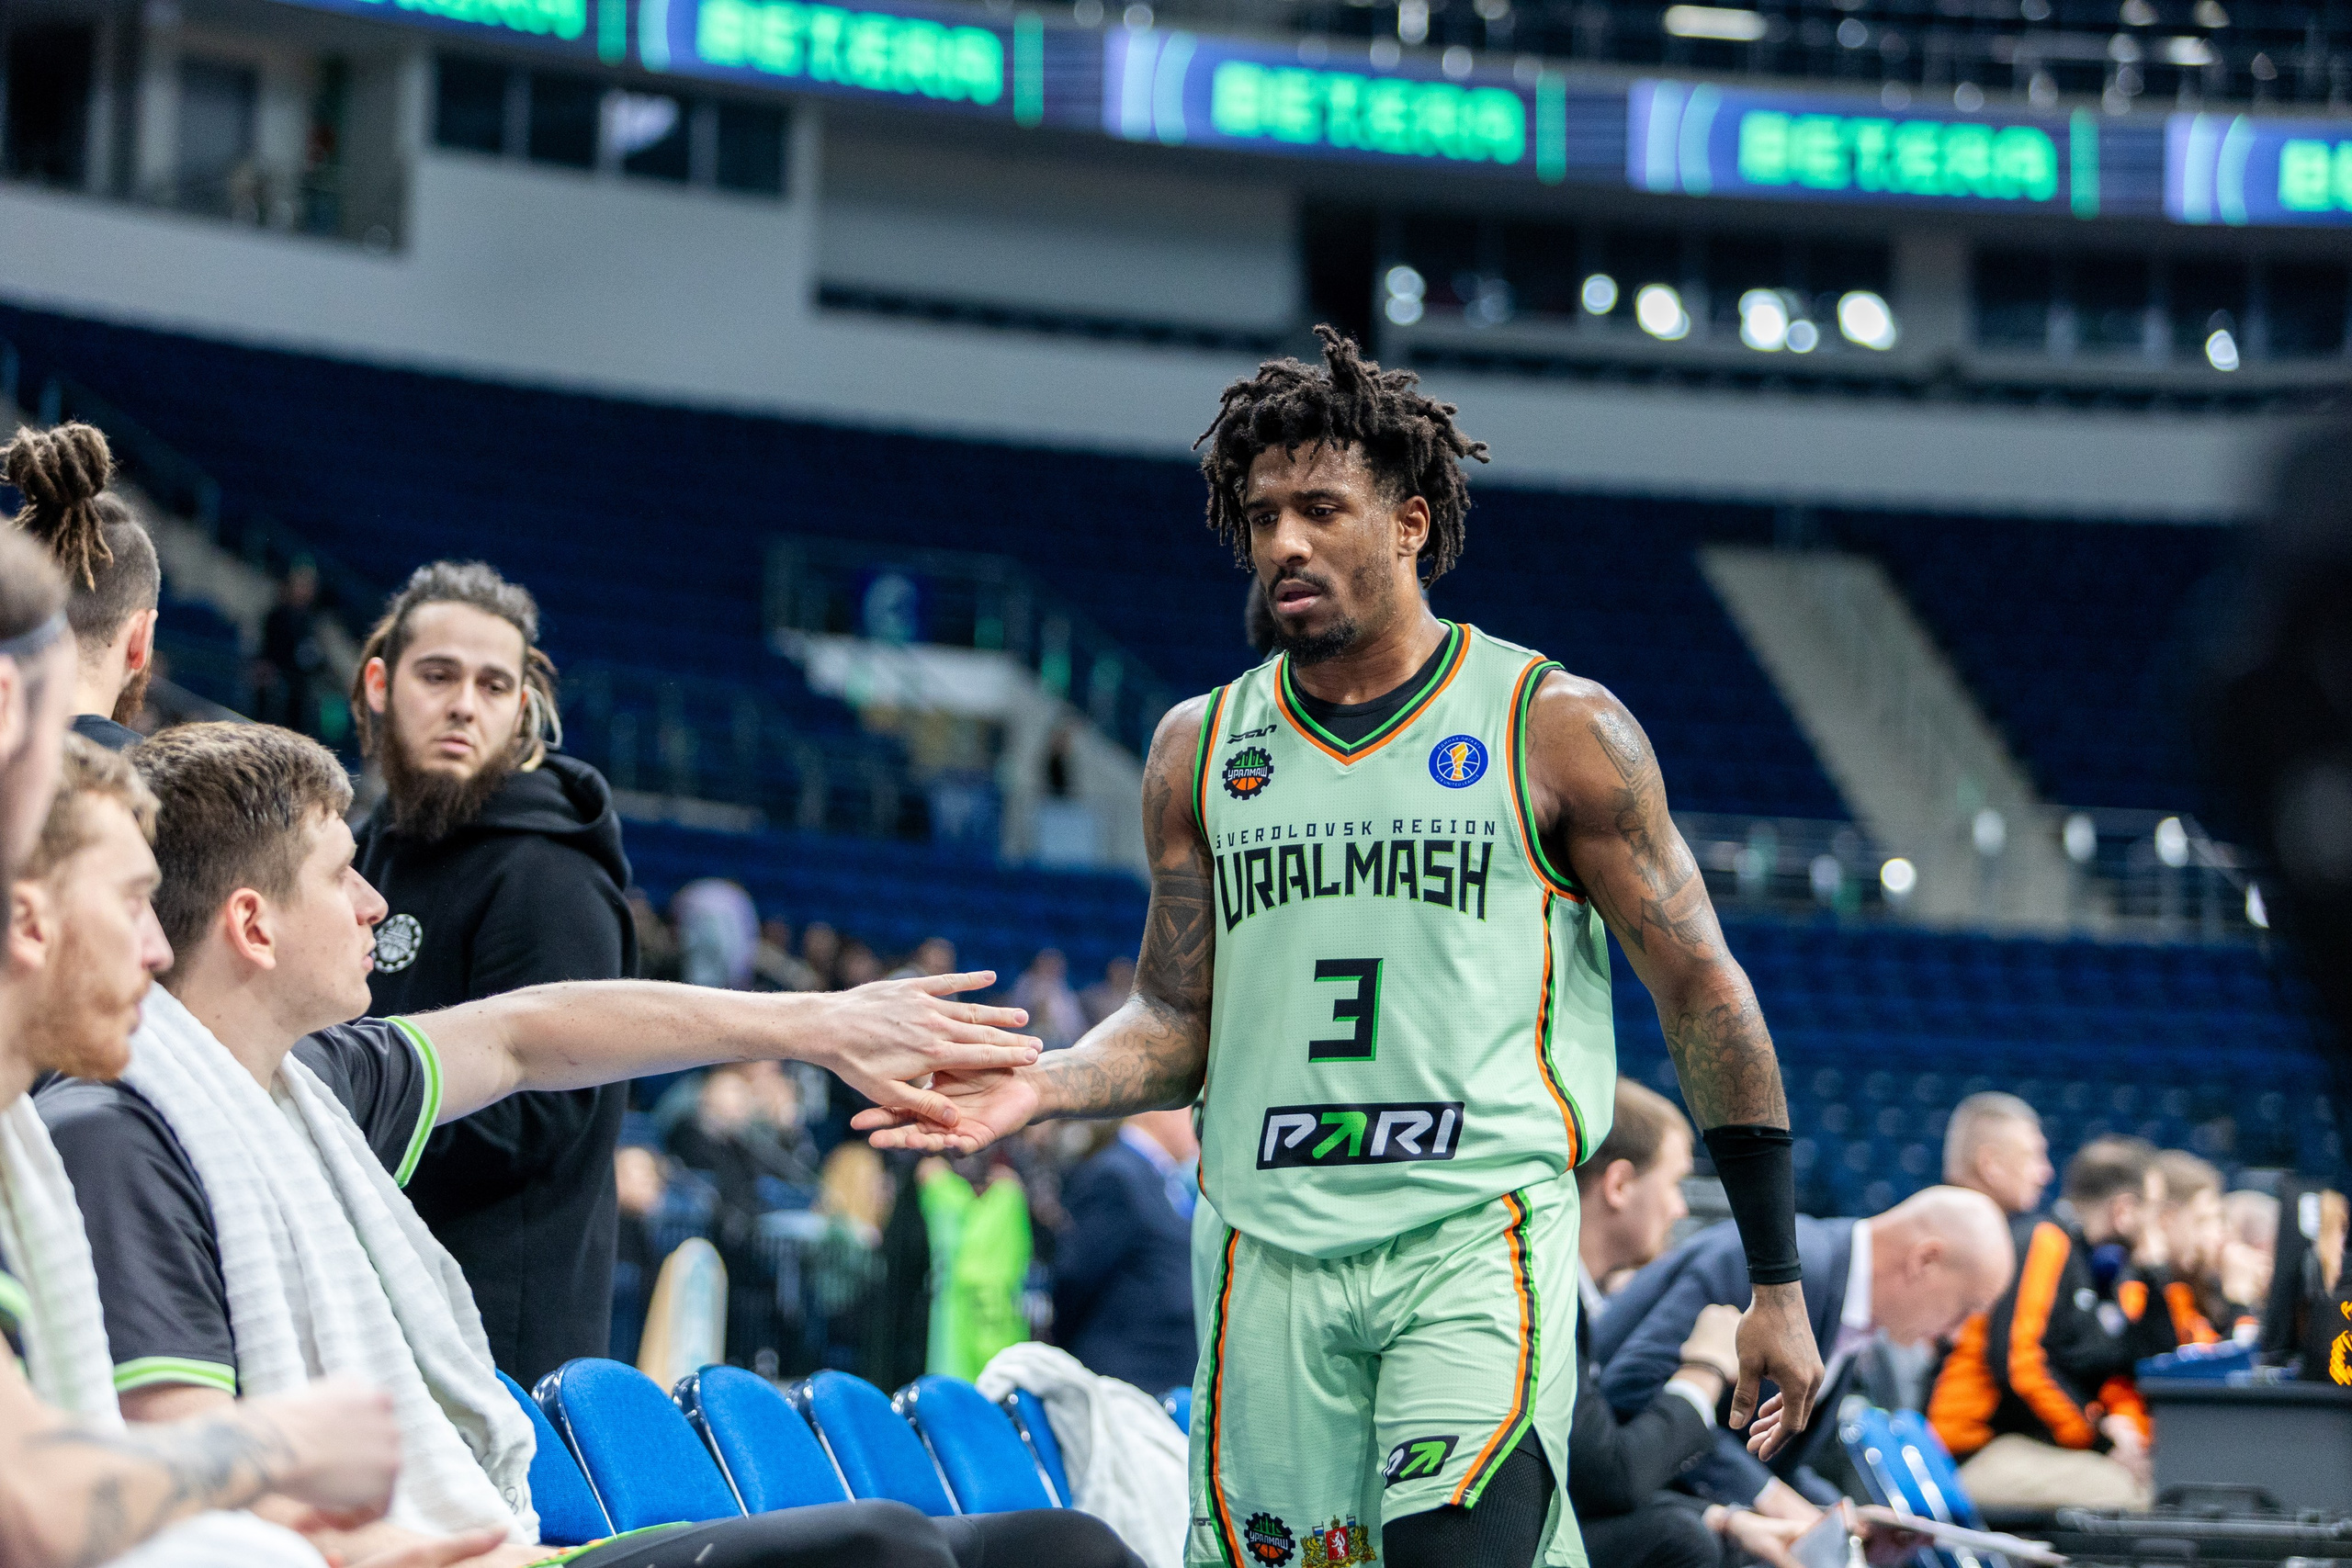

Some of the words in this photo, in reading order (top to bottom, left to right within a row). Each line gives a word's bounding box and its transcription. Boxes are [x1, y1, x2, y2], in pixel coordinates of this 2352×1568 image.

[1227, 765, 1268, 782] УРАЛМАШ
[1393, 818, 1496, 836] REGION
[1216, 839, 1494, 935] URALMASH
[1307, 957, 1385, 1064] 3
[1250, 1530, 1289, 1551] УРАЛМАШ
